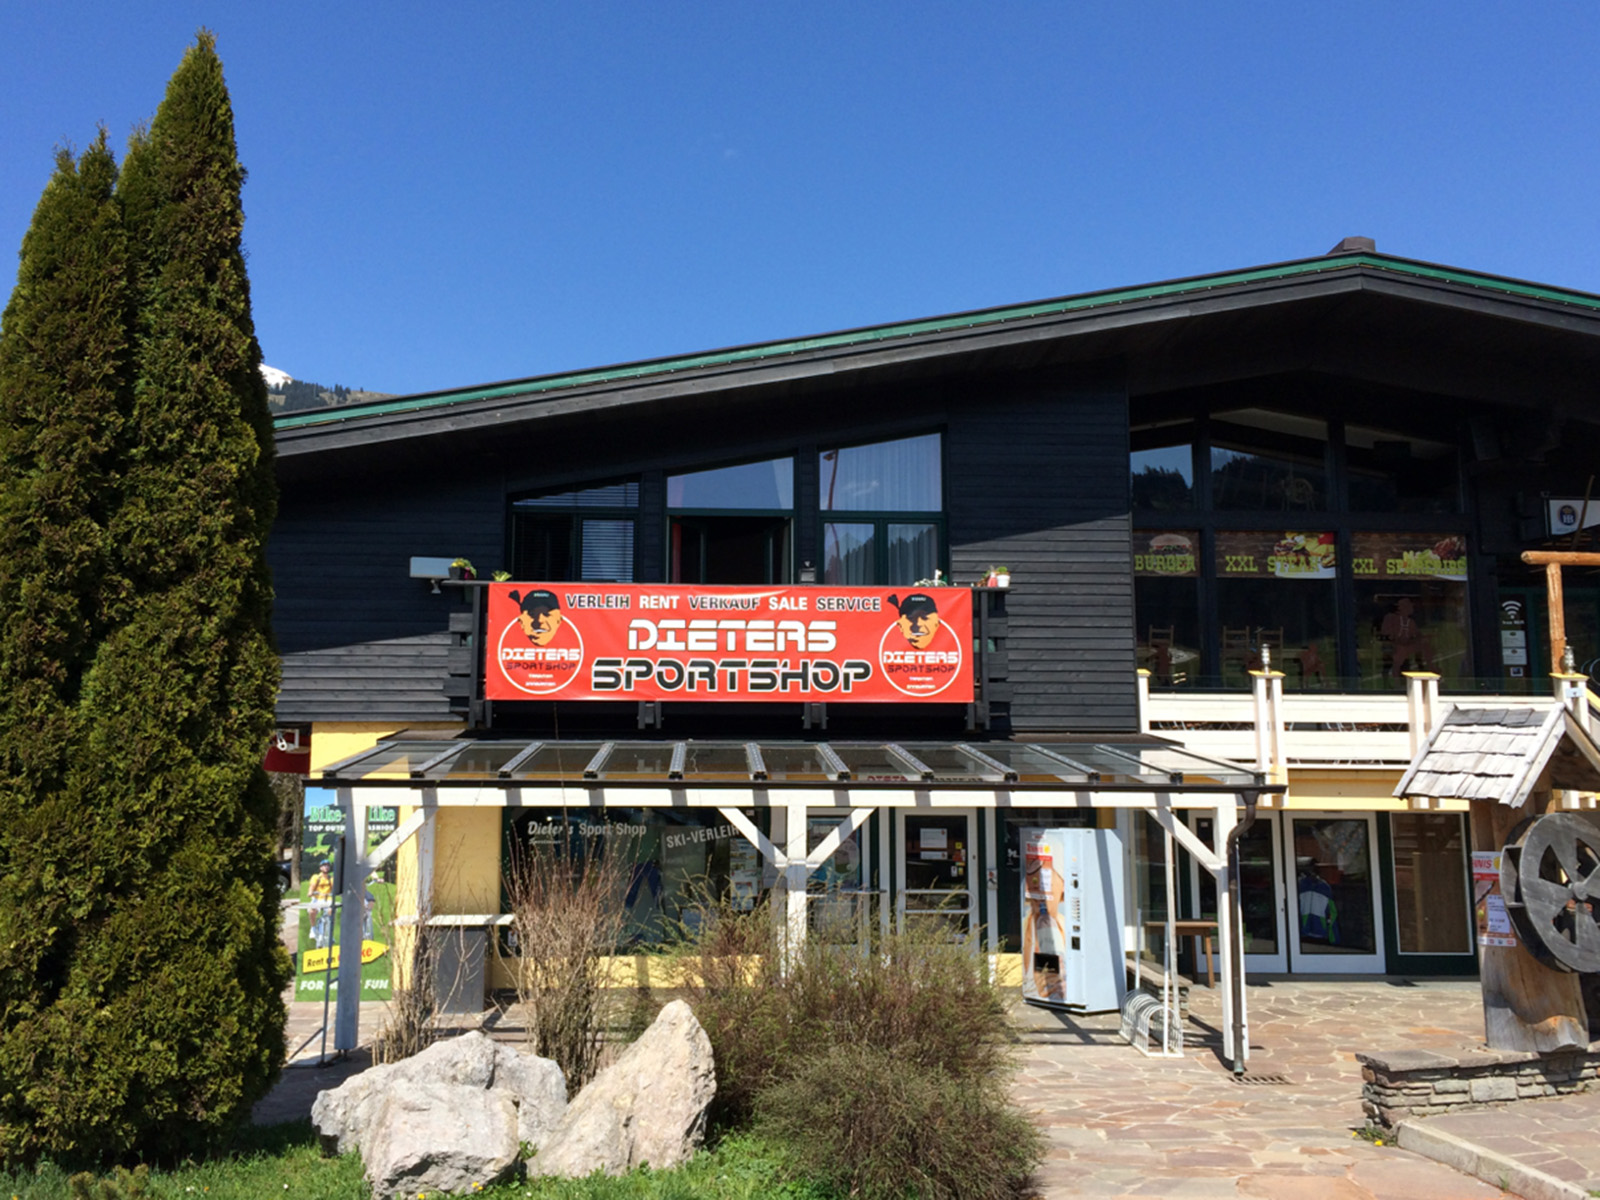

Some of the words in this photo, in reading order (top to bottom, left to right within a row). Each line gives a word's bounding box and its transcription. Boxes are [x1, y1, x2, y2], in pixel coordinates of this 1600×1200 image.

[1134, 554, 1196, 571] BURGER
[1225, 556, 1258, 572] XXL
[1267, 555, 1320, 573] STEAK
[565, 593, 631, 610] VERLEIH
[639, 595, 680, 610] RENT
[688, 594, 761, 611] VERKAUF
[768, 596, 808, 611] SALE
[816, 596, 881, 612] SERVICE
[628, 618, 837, 652] DIETERS
[502, 648, 580, 661] DIETERS
[883, 651, 959, 664] DIETERS
[591, 657, 873, 693] SPORTSHOP
[308, 806, 342, 823] Bike
[308, 824, 324, 832] TOP
[579, 822, 613, 837] Sport
[616, 823, 647, 838] Shop
[666, 824, 740, 849] SKI-VERLEIH
[307, 957, 325, 967] Rent
[300, 980, 325, 991] FOR
[364, 979, 389, 990] FUN
